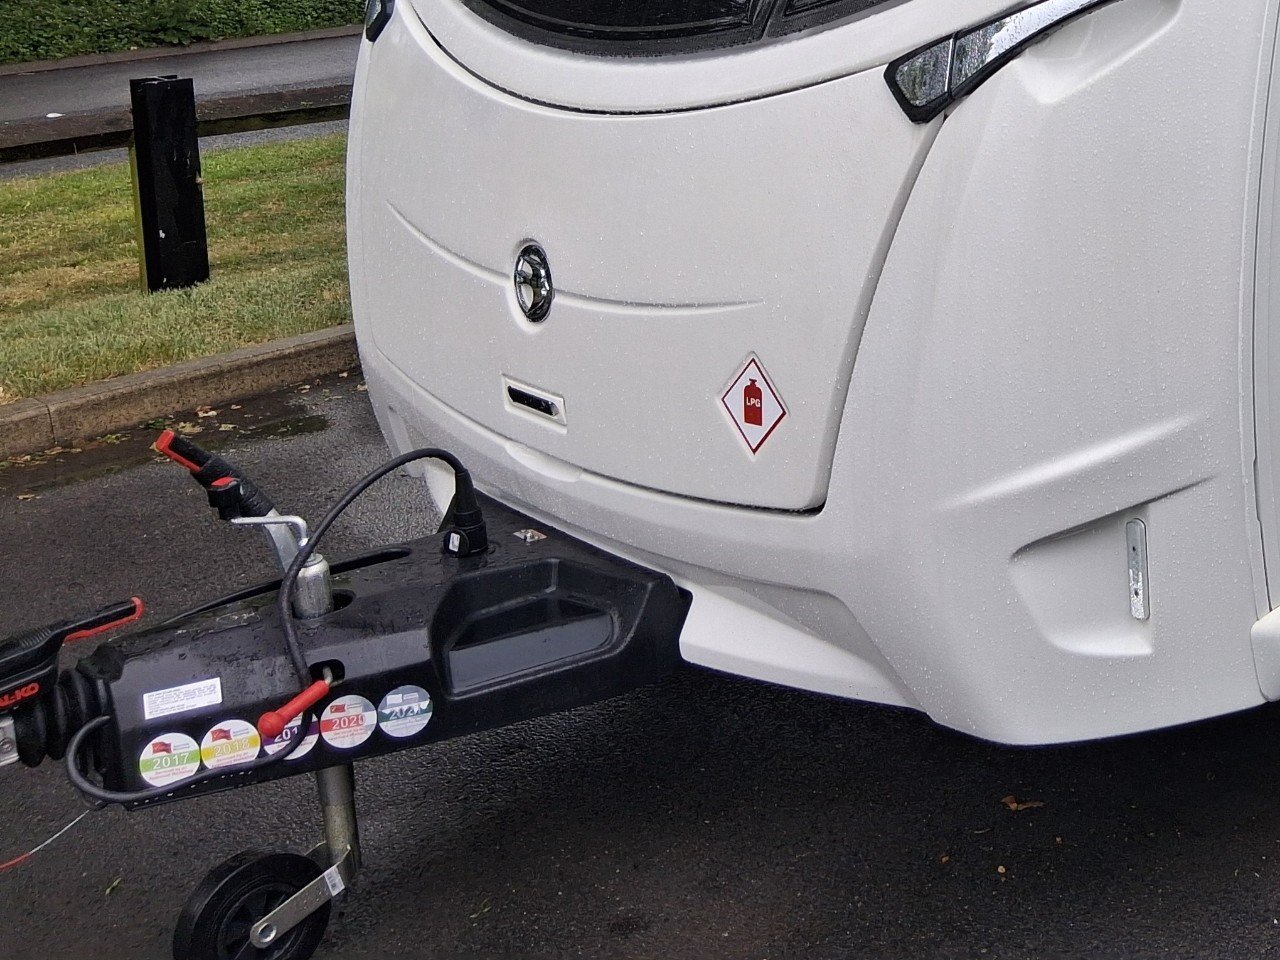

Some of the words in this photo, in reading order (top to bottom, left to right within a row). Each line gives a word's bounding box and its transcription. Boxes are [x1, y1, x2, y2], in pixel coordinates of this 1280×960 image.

[746, 396, 761, 408] LPG
[332, 713, 367, 731] 2020
[274, 726, 299, 743] 201
[213, 738, 251, 757] 2018
[152, 752, 190, 770] 2017
